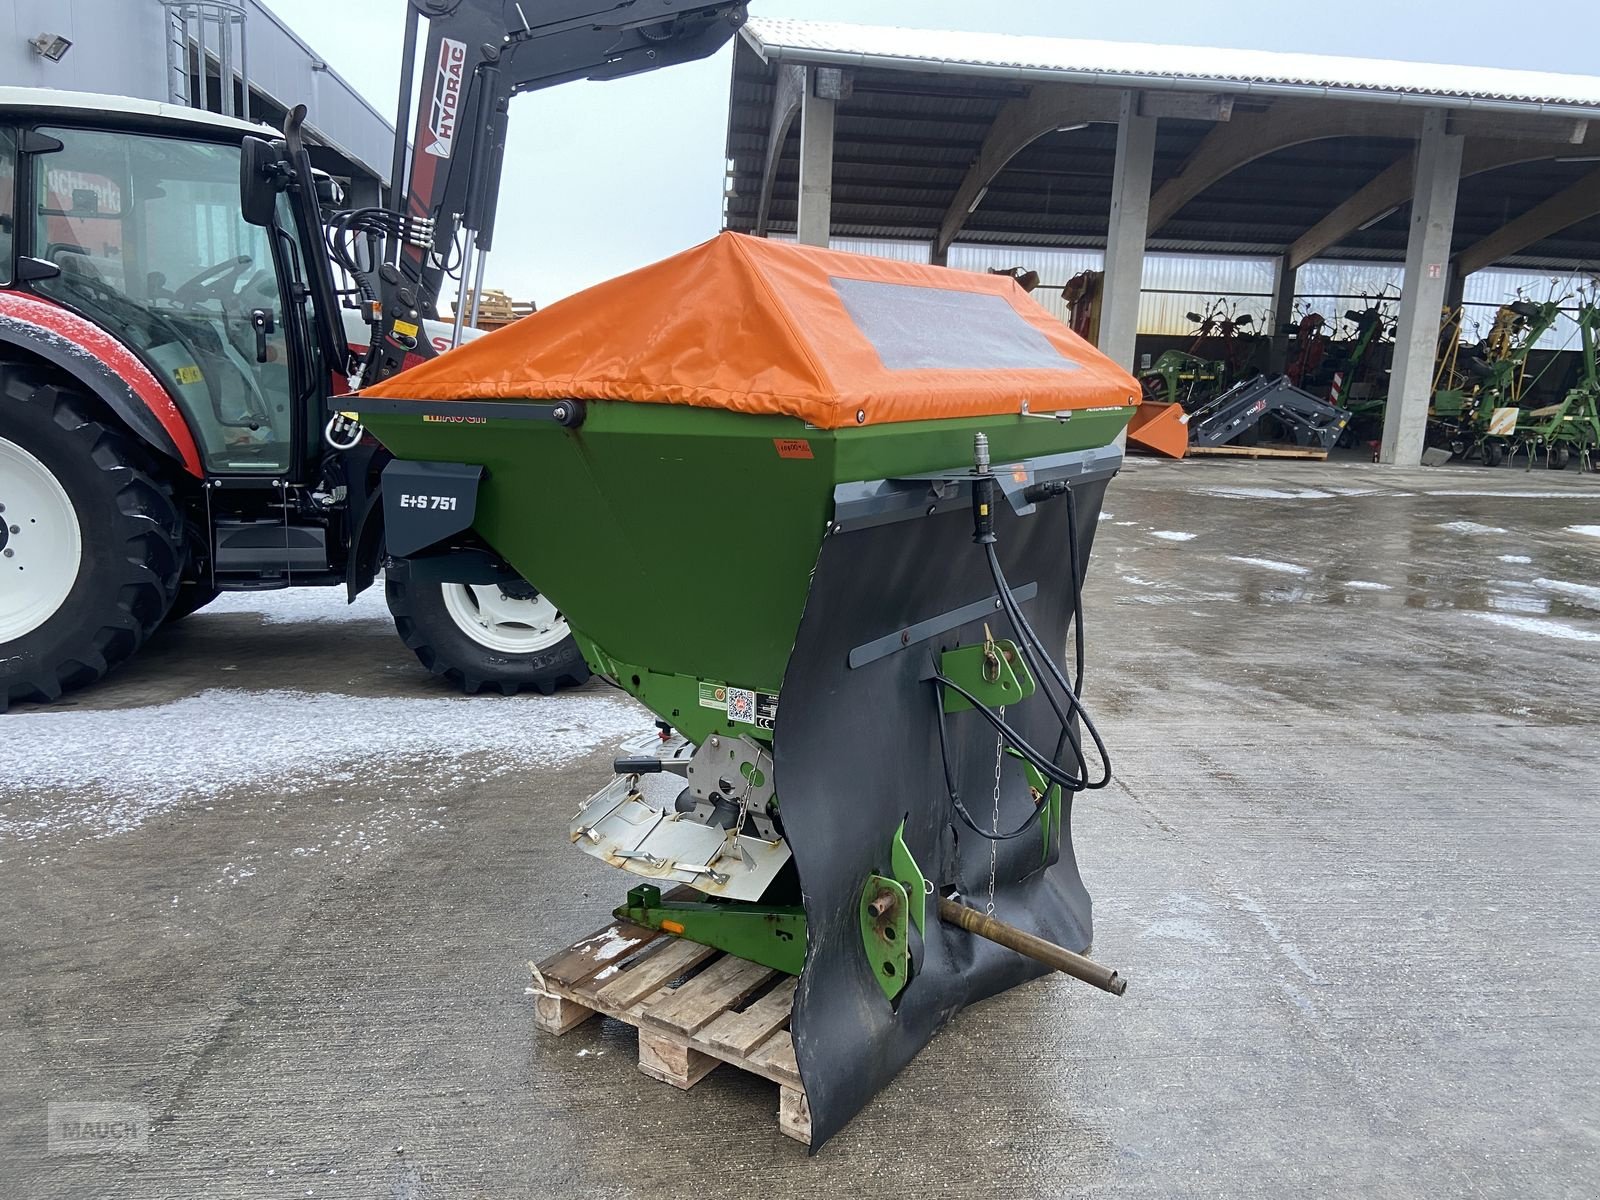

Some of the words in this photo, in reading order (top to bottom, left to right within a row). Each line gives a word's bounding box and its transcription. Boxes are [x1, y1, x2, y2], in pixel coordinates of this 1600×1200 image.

[439, 47, 464, 140] HYDRAC
[400, 494, 428, 508] E+S
[431, 496, 457, 511] 751
